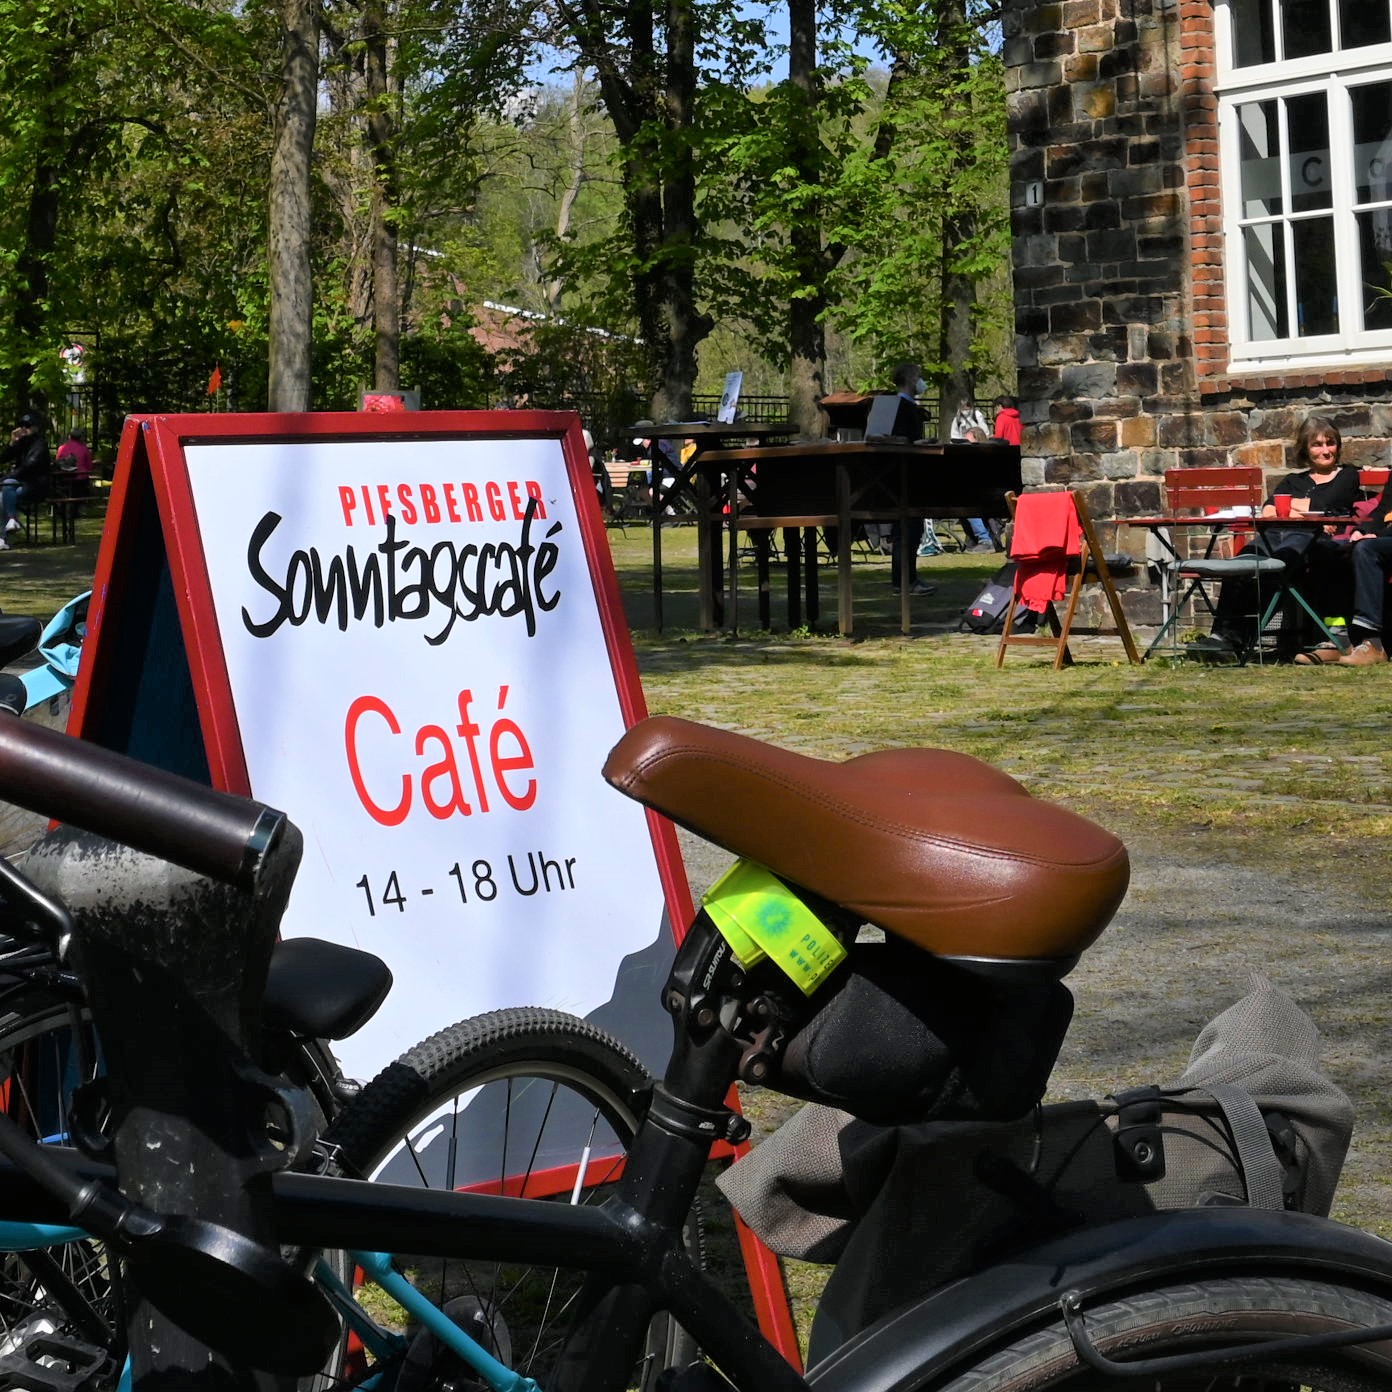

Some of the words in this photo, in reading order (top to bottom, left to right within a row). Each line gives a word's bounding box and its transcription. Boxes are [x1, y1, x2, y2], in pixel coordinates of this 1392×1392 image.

[338, 480, 549, 527] PIESBERGER
[241, 496, 563, 646] Sonntagscafé
[344, 685, 538, 827] Café
[355, 871, 407, 917] 14
[448, 859, 498, 904] 18
[508, 850, 577, 897] Uhr
